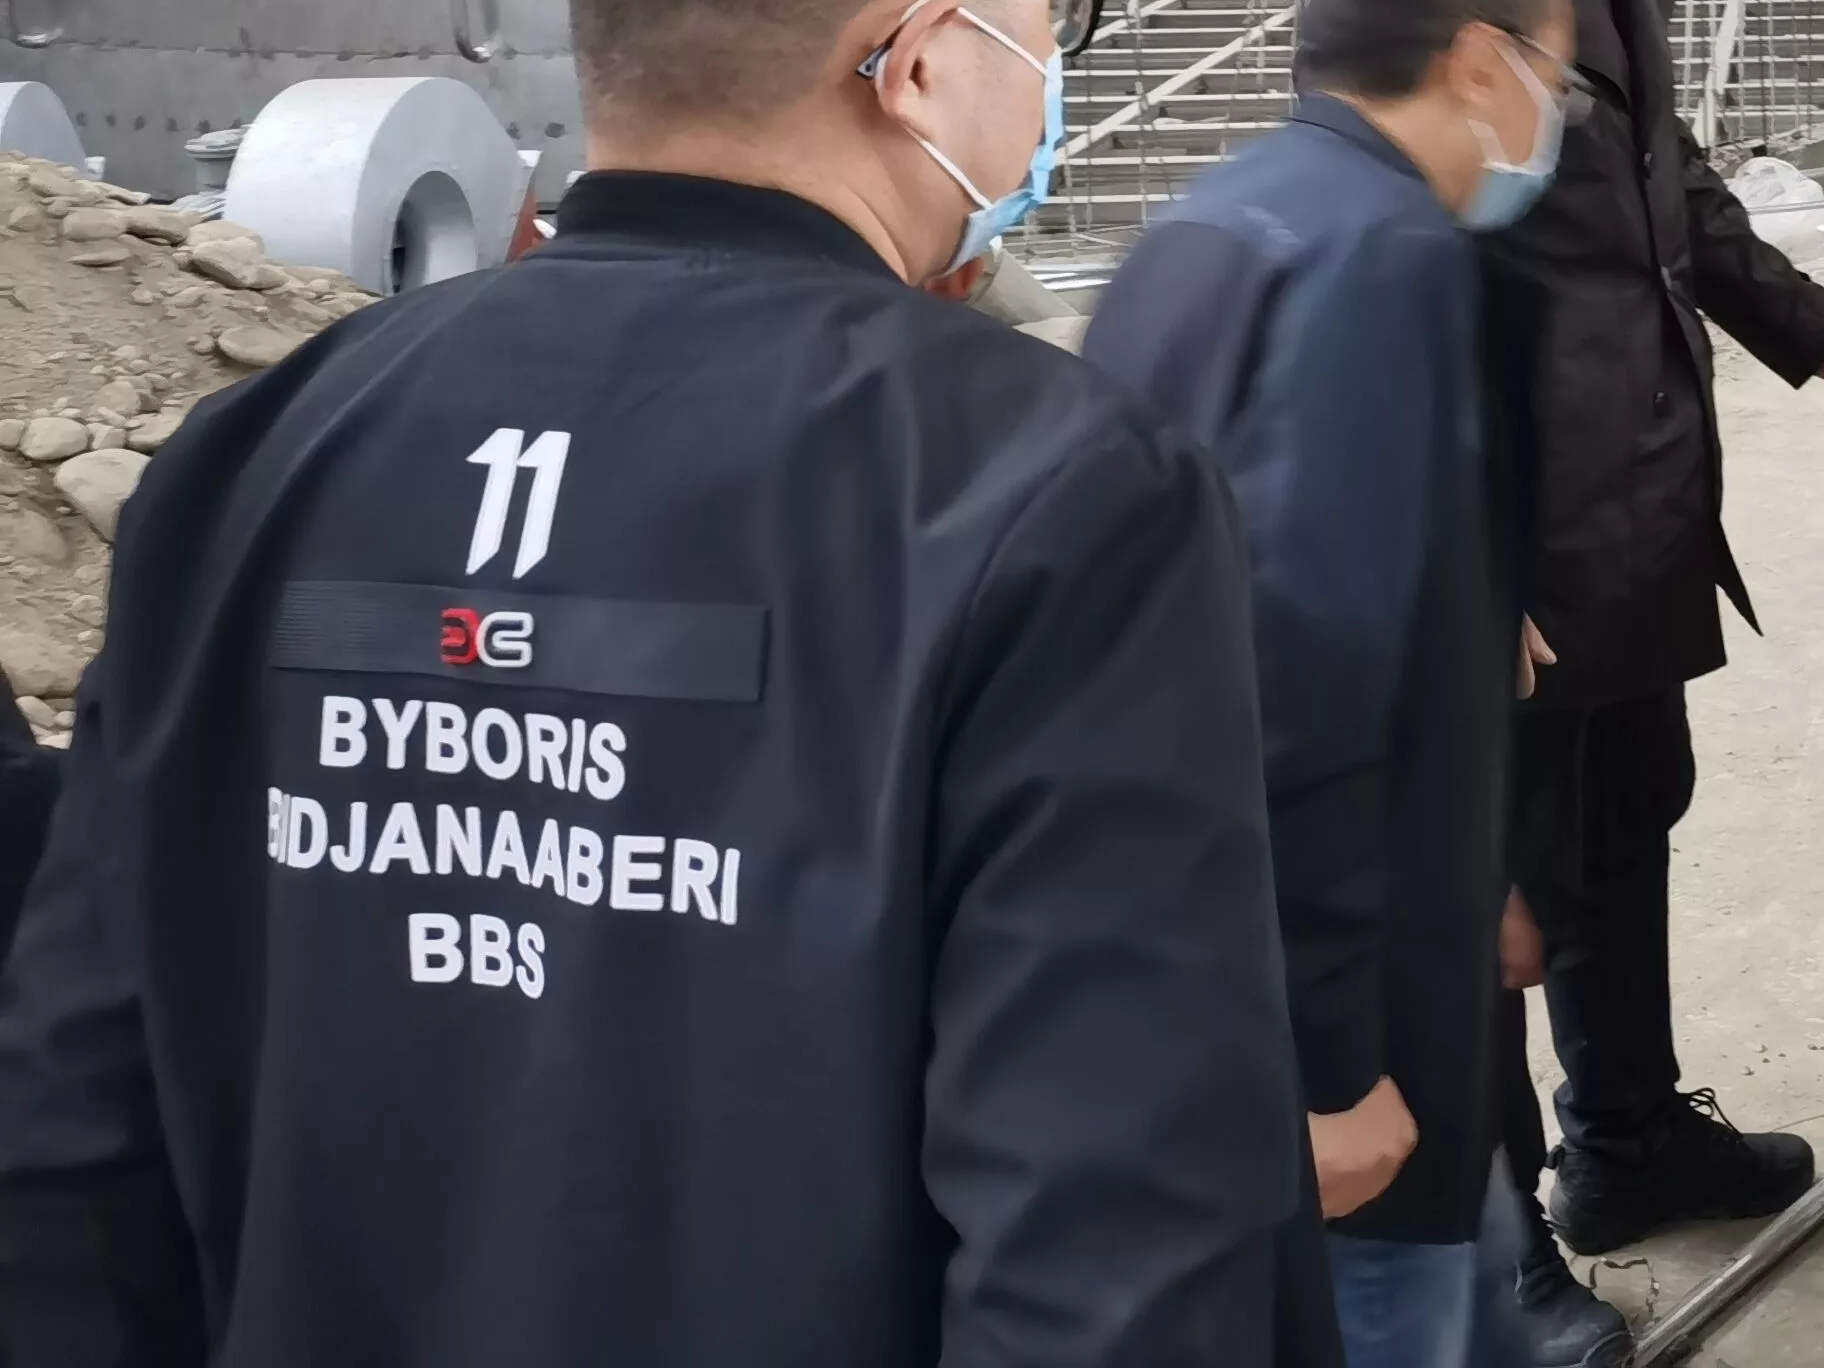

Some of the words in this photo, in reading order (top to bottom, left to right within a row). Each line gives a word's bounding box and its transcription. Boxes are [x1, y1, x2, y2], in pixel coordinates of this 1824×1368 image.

[466, 428, 571, 579] 11
[319, 695, 627, 800] BYBORIS
[408, 912, 546, 1000] BBS
